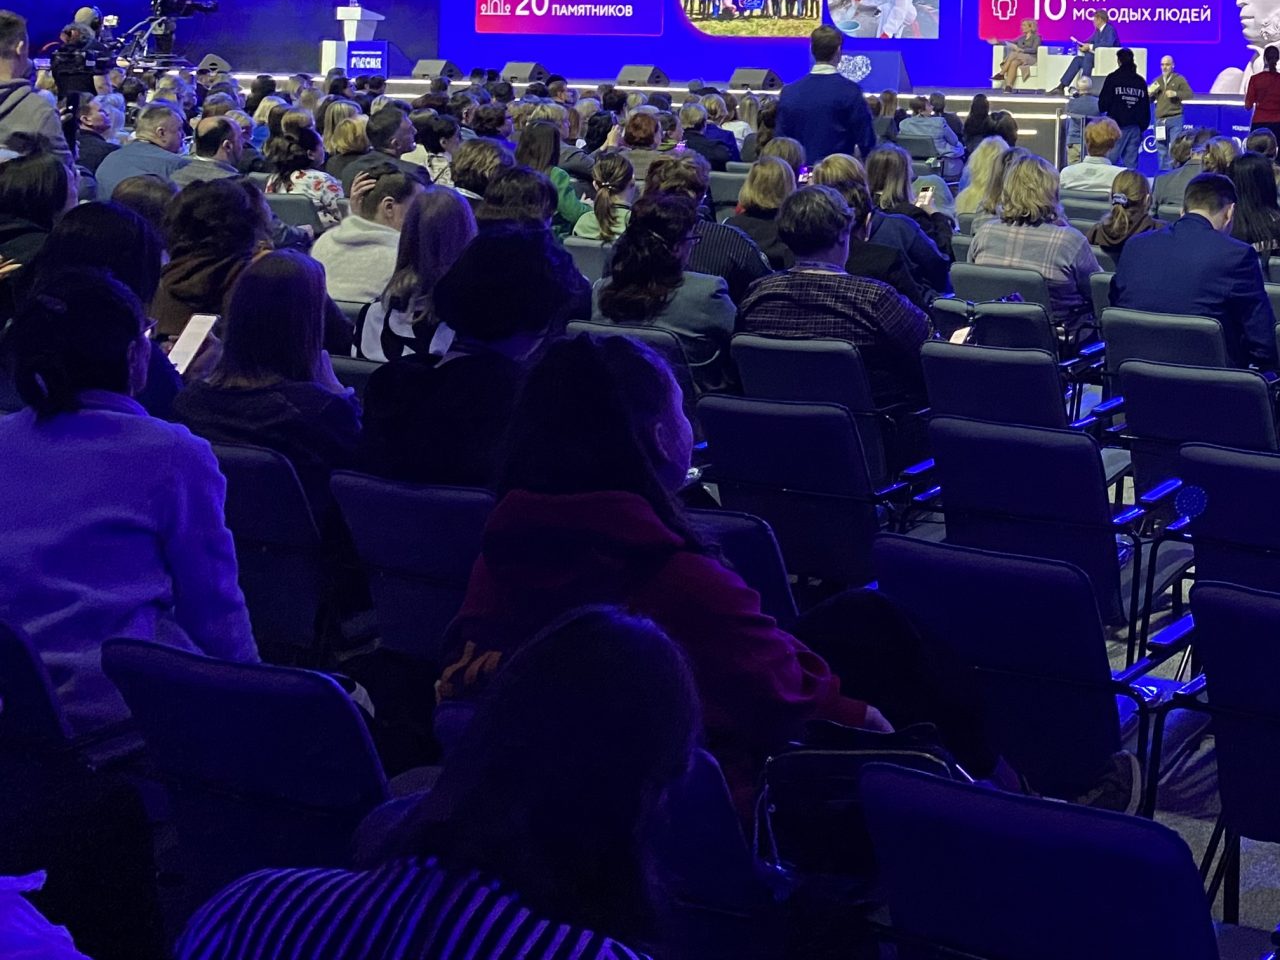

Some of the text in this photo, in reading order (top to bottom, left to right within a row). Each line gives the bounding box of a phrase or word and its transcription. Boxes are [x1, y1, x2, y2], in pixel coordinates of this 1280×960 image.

[551, 4, 633, 17] ПАМЯТНИКОВ
[1072, 5, 1211, 24] МООДЫХ ЛЮДЕЙ
